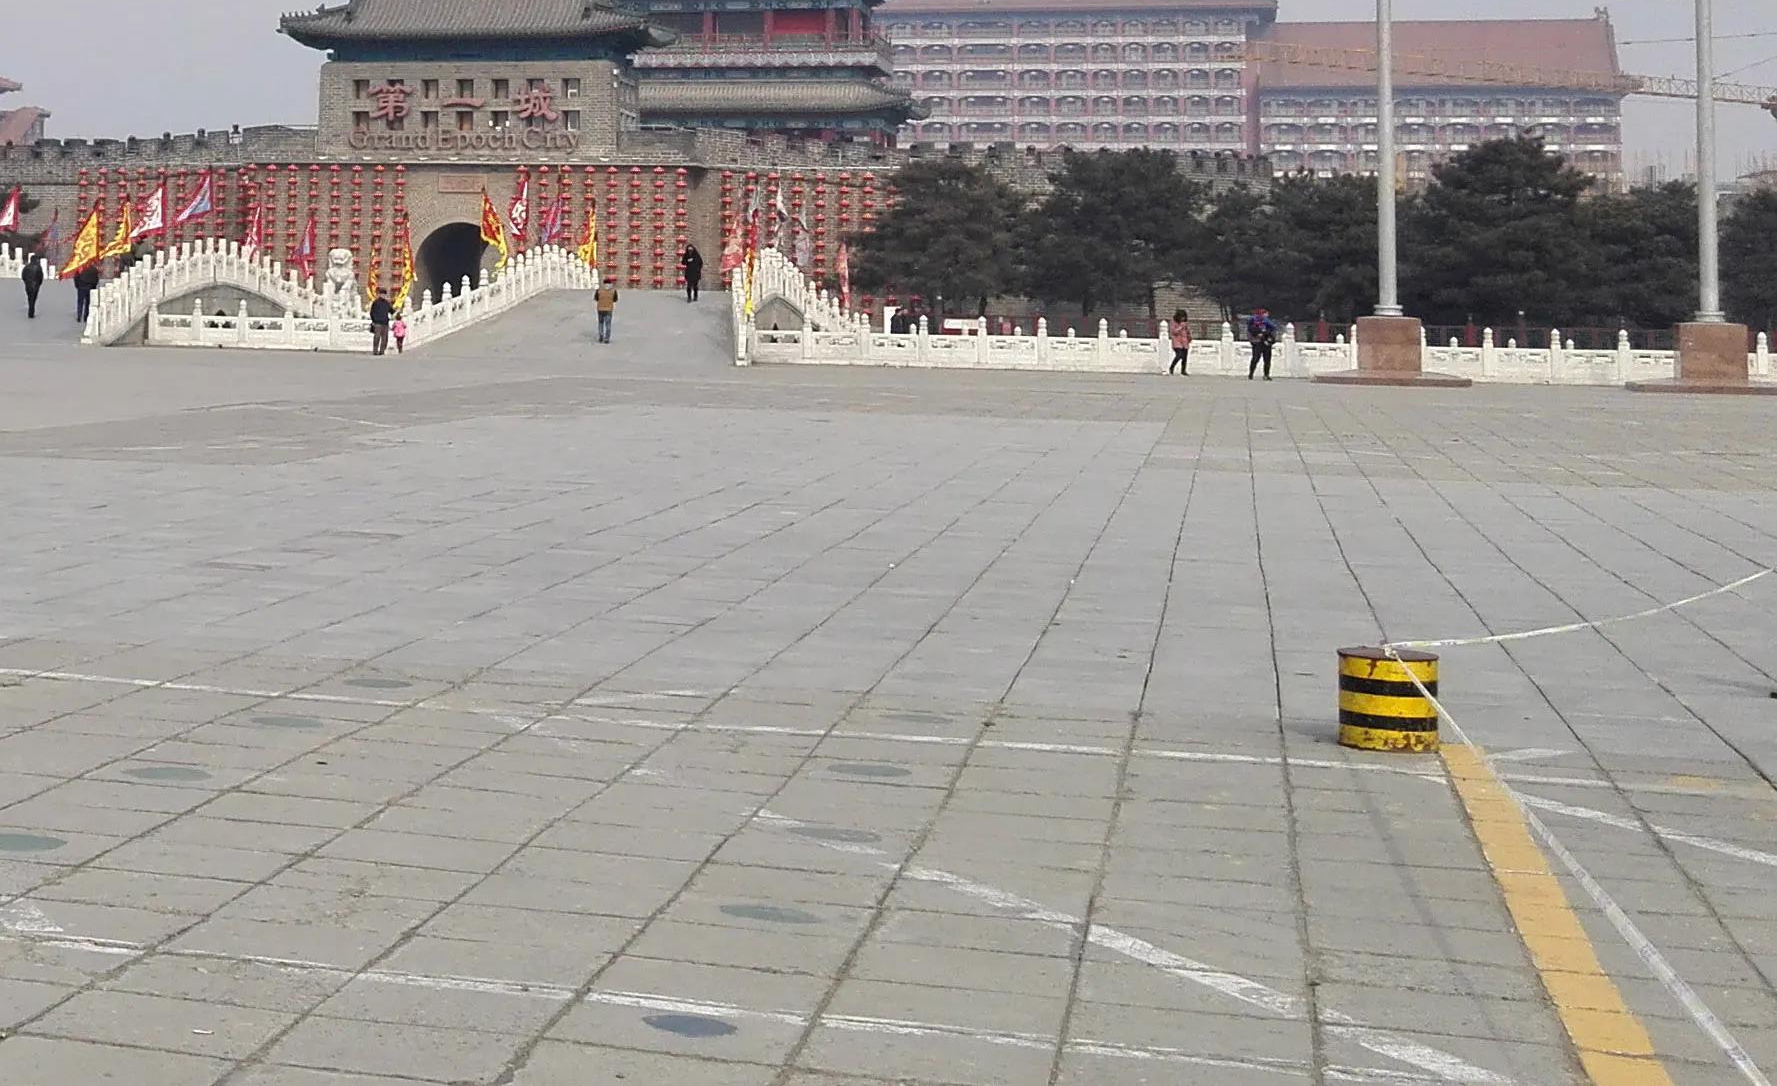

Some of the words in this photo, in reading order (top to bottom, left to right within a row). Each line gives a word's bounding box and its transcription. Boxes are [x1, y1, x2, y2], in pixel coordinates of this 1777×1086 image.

[368, 82, 559, 121] 第一城
[349, 127, 430, 150] Grand
[438, 128, 518, 151] Epoch
[523, 127, 580, 154] City
